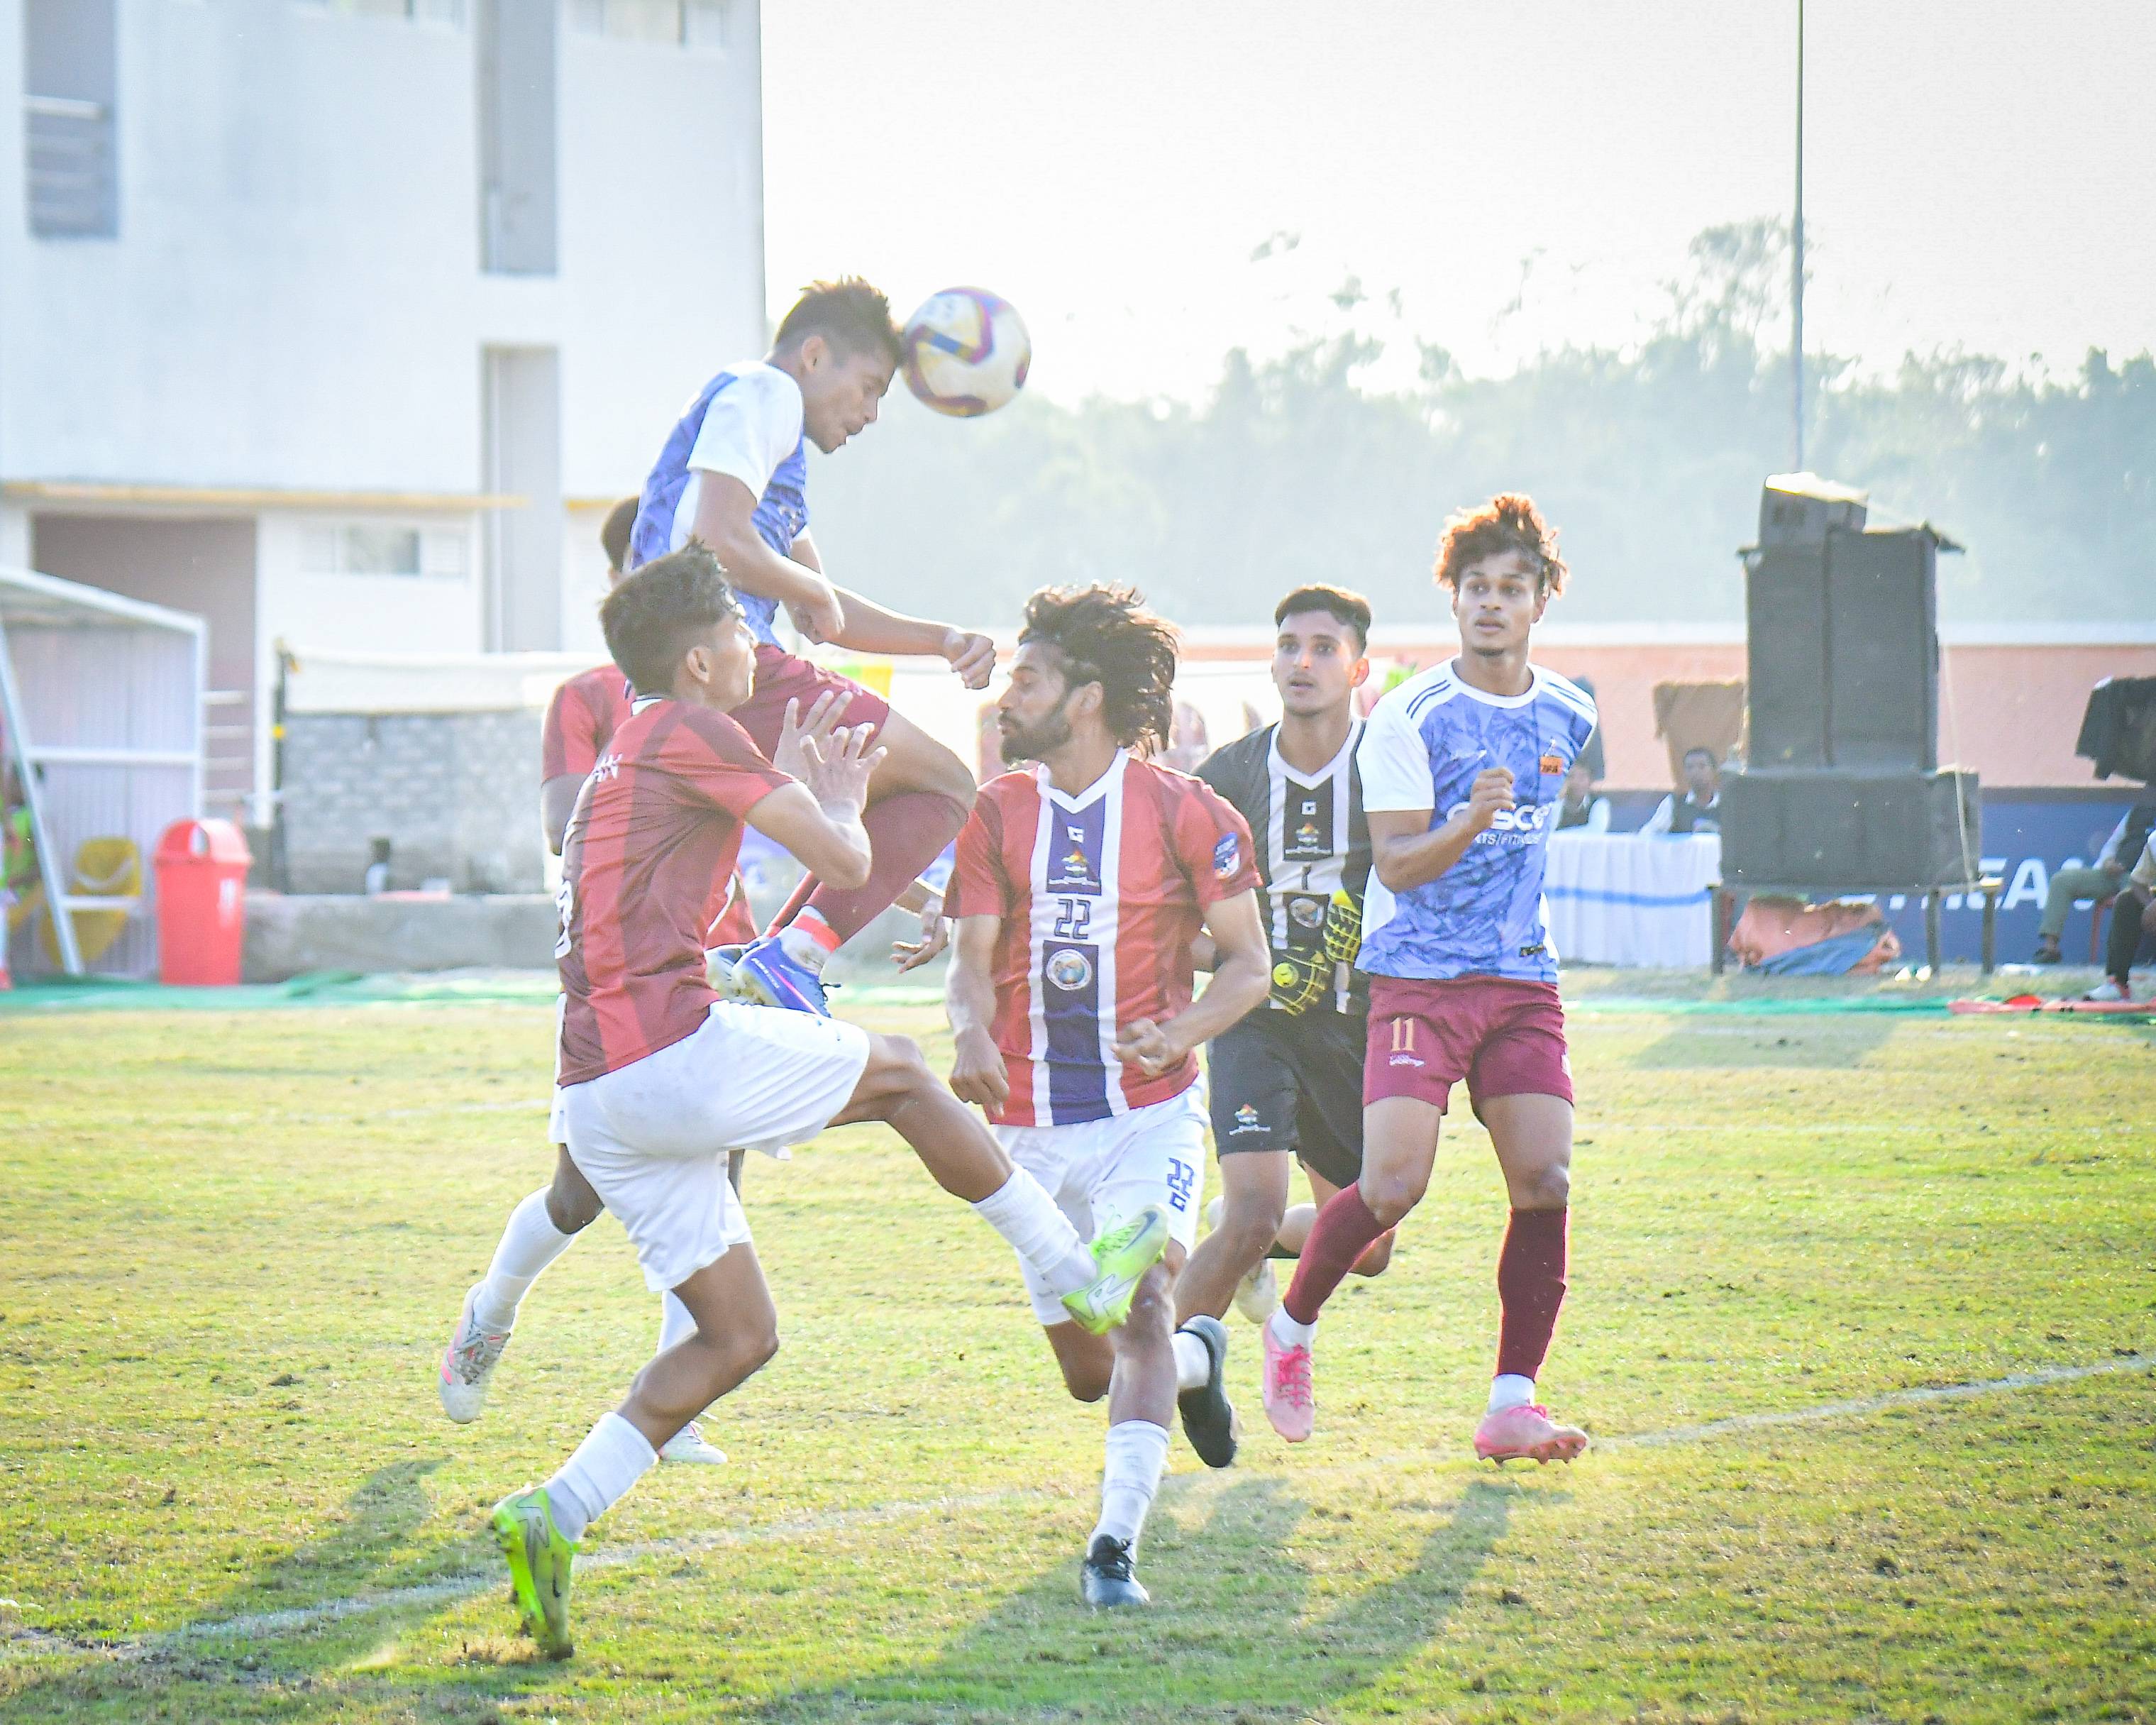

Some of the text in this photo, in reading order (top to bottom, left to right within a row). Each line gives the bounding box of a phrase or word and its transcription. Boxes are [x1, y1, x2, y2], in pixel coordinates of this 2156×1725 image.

[1054, 898, 1091, 939] 22
[1390, 1017, 1415, 1051] 11
[1166, 1157, 1195, 1199] 22
